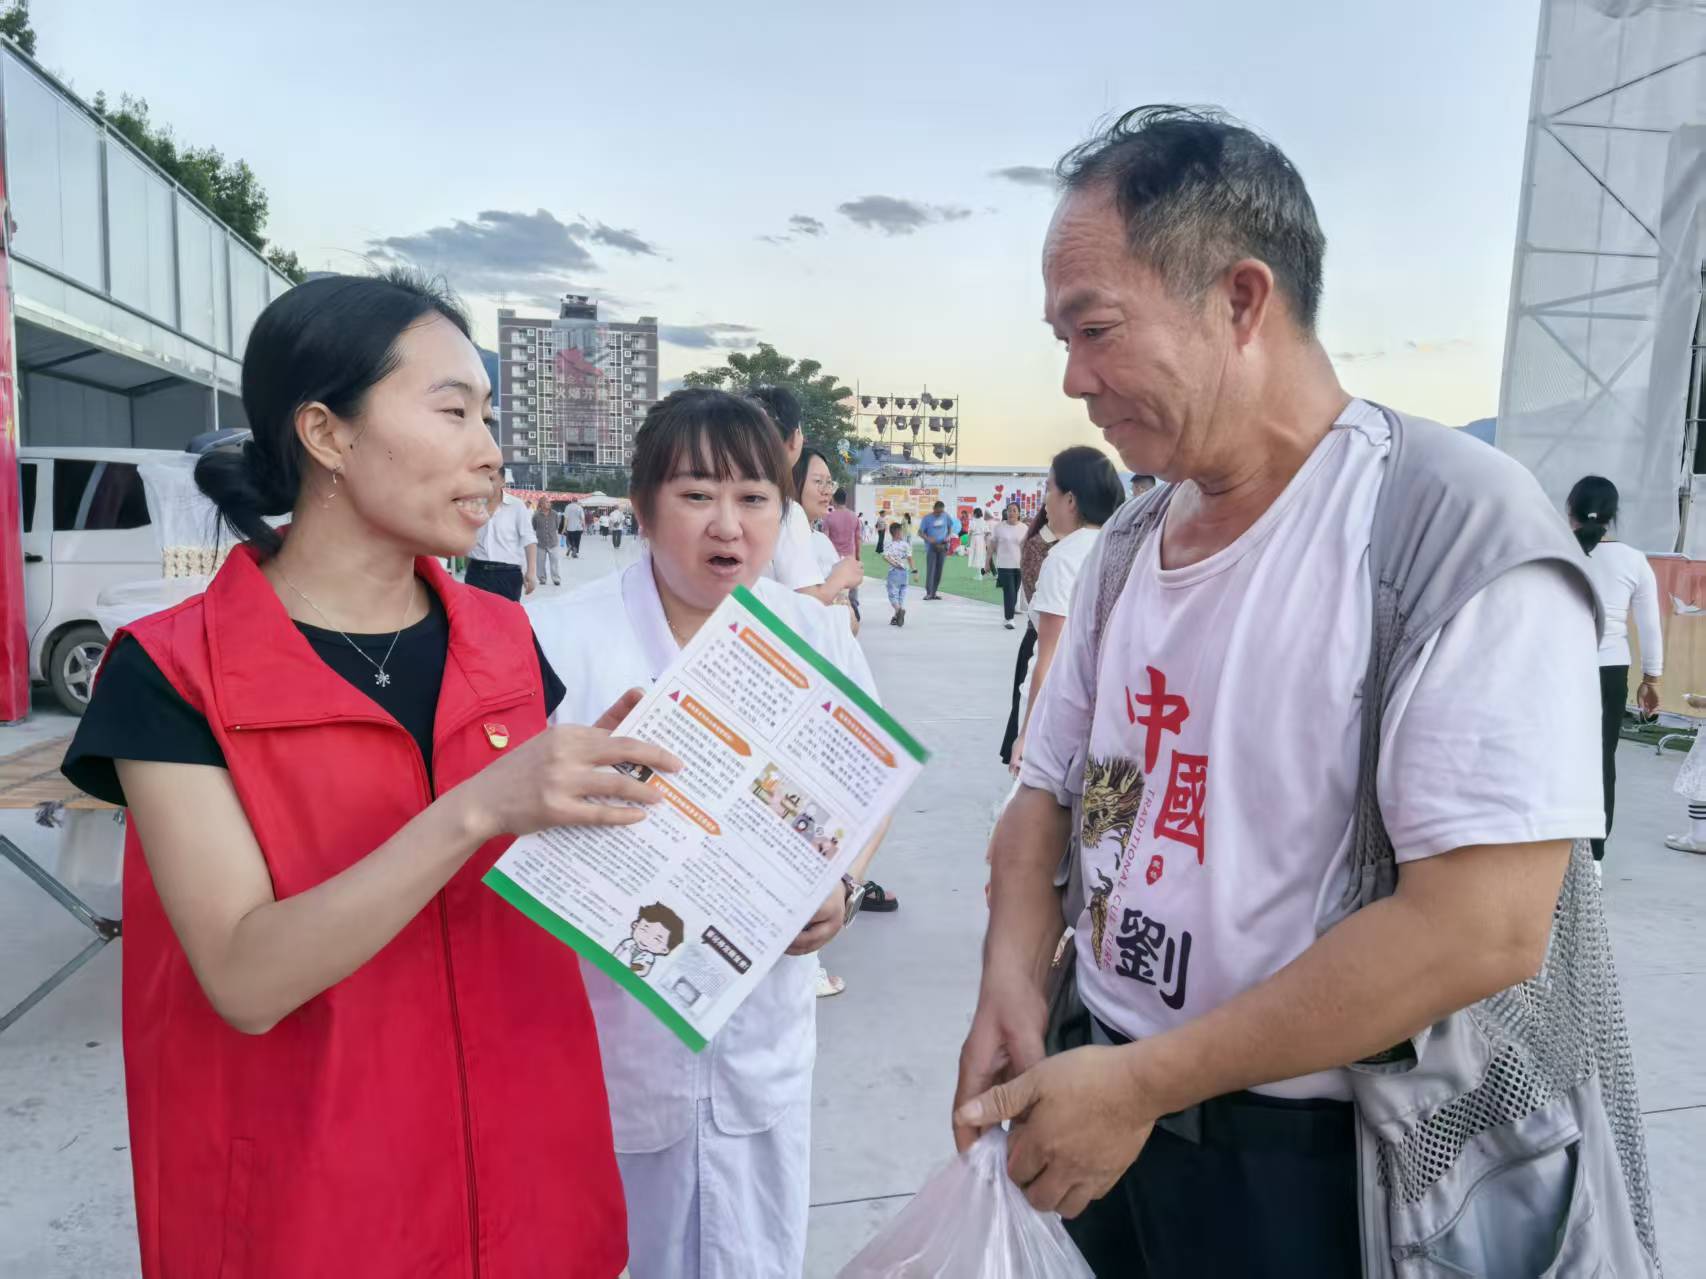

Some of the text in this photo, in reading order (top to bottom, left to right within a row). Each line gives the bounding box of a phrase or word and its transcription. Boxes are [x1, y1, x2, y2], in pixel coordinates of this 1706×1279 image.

[1125, 665, 1209, 865] 中國
[1117, 788, 1156, 888] TRADITIONAL
[1103, 894, 1122, 969] CULTURE
